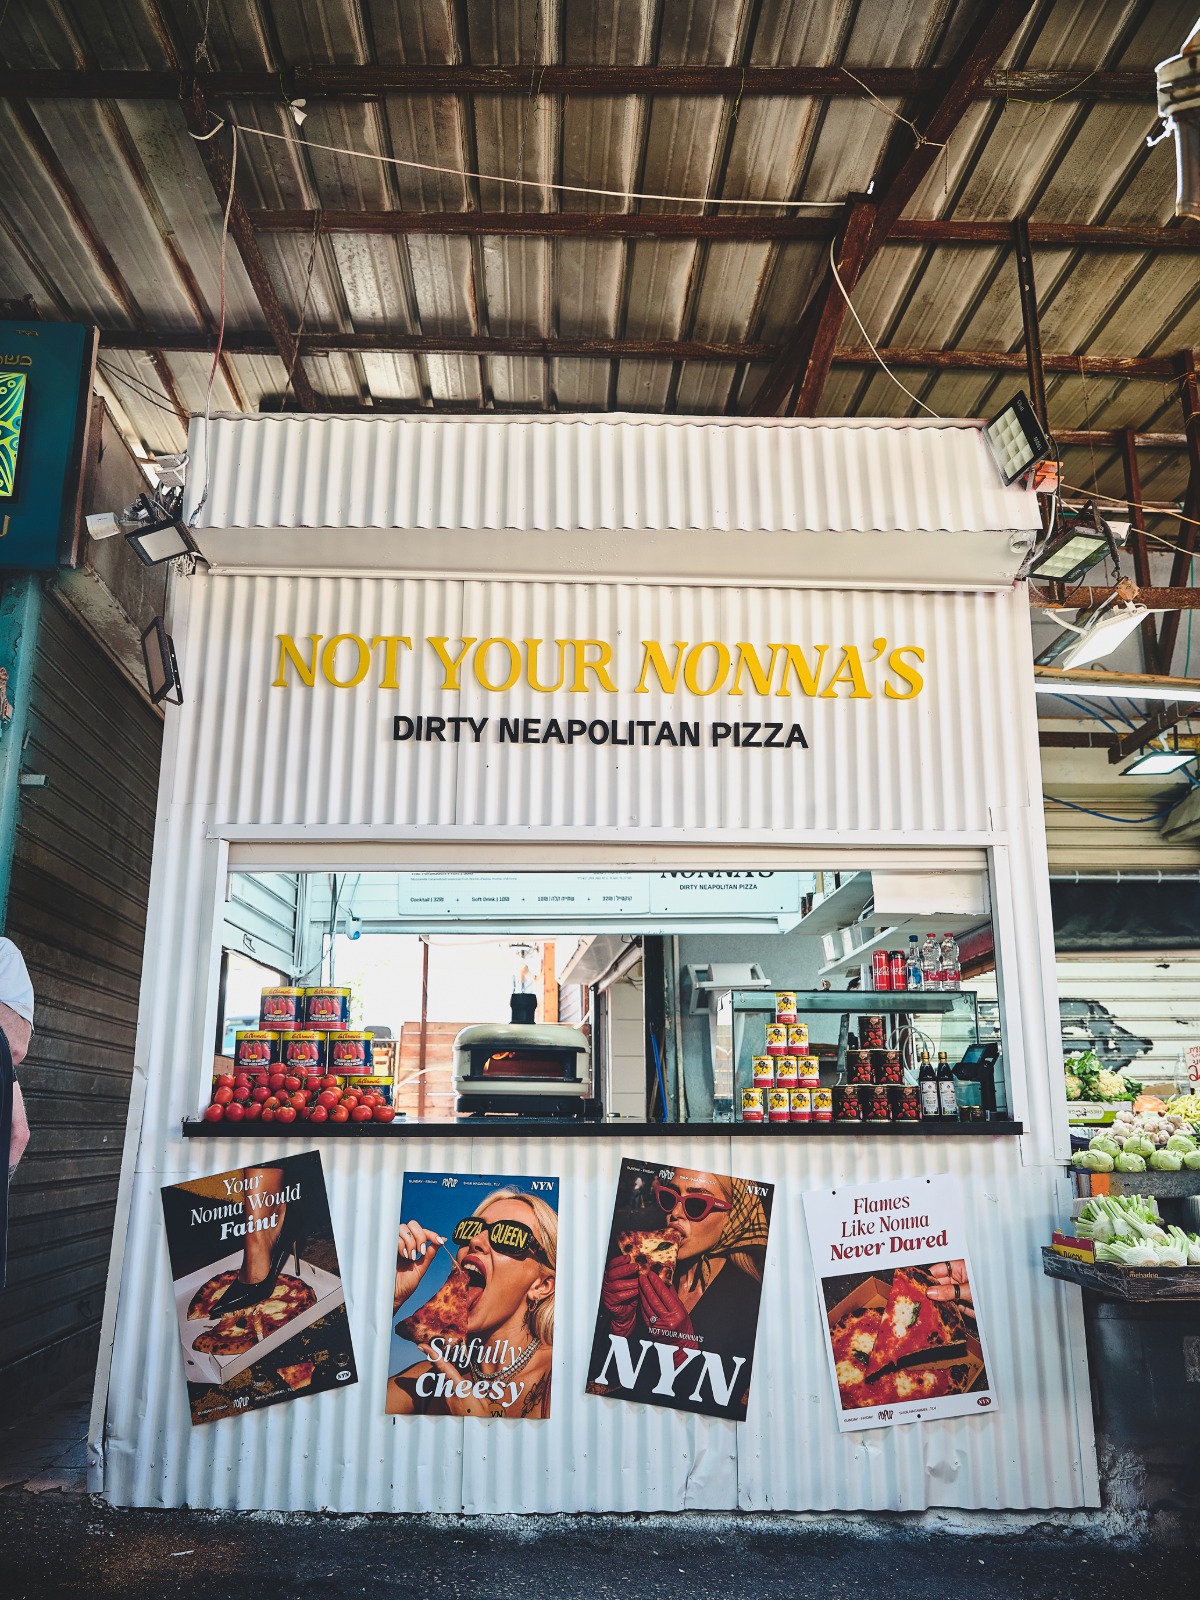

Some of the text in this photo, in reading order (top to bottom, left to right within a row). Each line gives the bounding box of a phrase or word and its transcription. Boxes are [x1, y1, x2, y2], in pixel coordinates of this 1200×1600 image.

[272, 634, 926, 700] NOT YOUR NONNA'S
[393, 716, 809, 749] DIRTY NEAPOLITAN PIZZA
[222, 1174, 264, 1196] Your
[441, 1177, 459, 1188] POPUP
[530, 1180, 555, 1191] NYN
[745, 1185, 769, 1197] NYN
[190, 1183, 302, 1226] Nonna Would
[853, 1195, 911, 1215] Flames
[219, 1212, 279, 1241] Faint
[455, 1220, 529, 1249] PIZZA QUEEN
[841, 1213, 930, 1238] Like Nonna
[830, 1229, 949, 1261] Never Dared
[648, 1327, 705, 1343] NOT YOUR NONNA'S
[426, 1337, 523, 1372] Sinfully
[594, 1333, 747, 1407] NYN
[415, 1372, 526, 1408] Cheesy
[877, 1409, 894, 1421] POPUP
